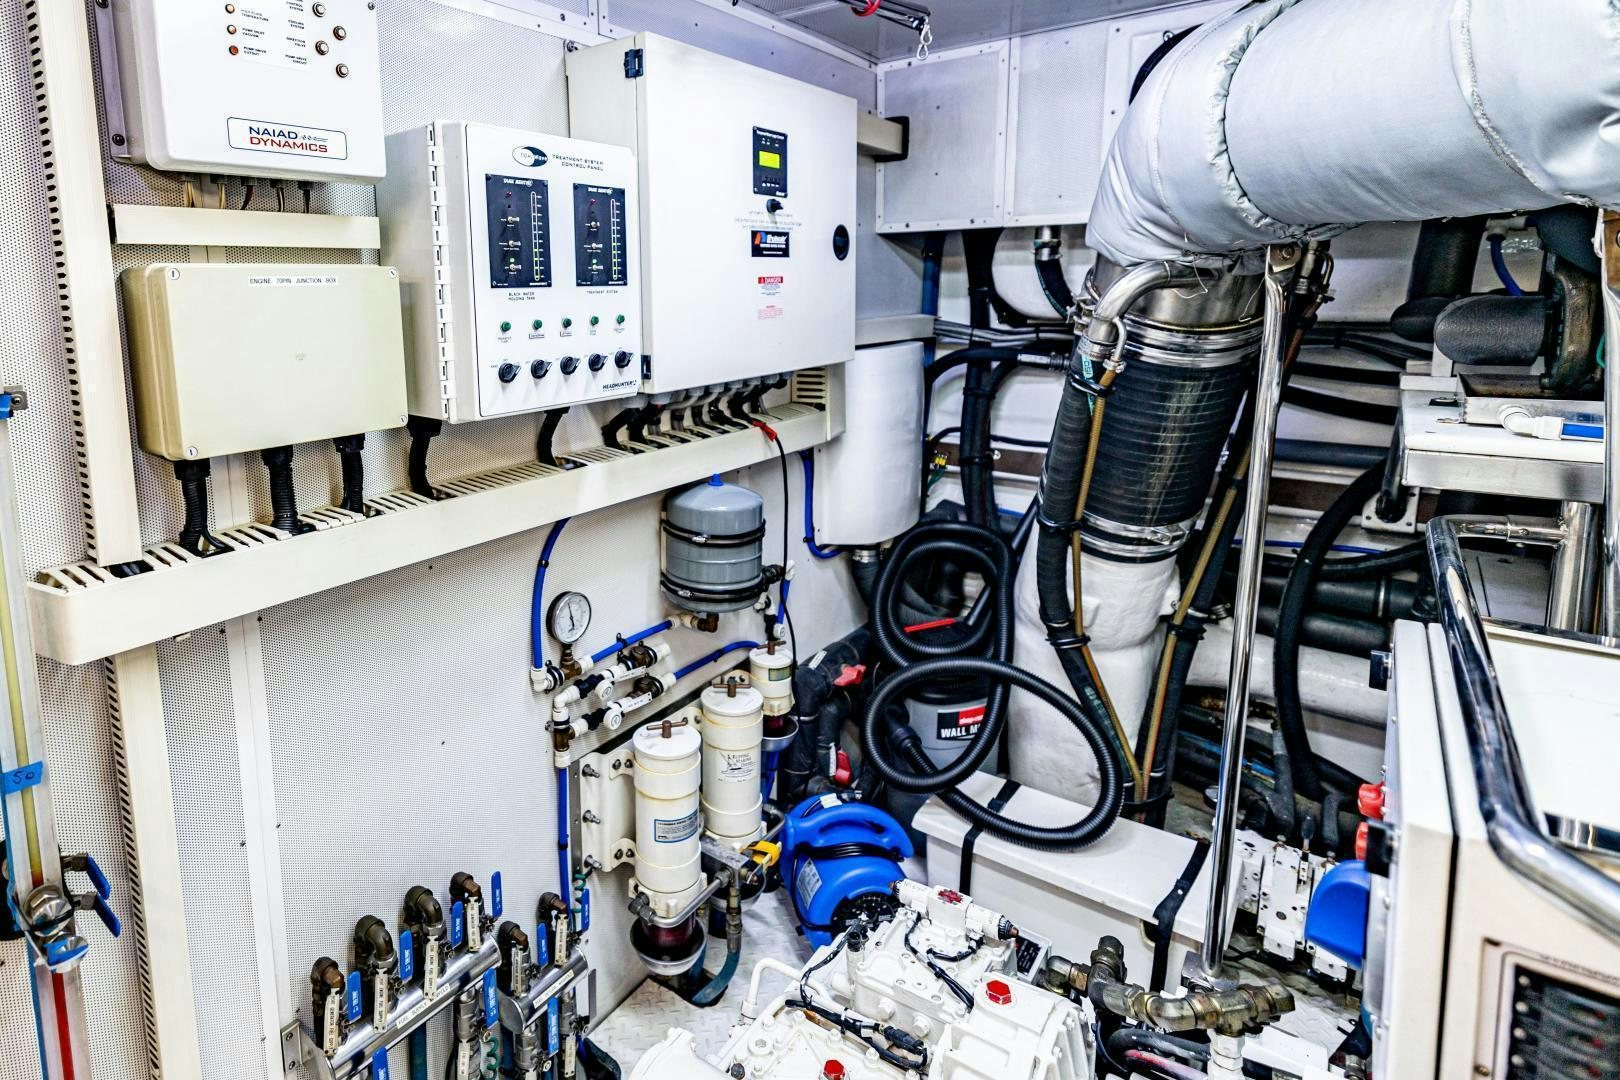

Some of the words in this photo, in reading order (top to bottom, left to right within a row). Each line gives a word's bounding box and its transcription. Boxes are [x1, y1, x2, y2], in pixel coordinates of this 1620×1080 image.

[249, 126, 298, 140] NAIAD
[250, 136, 328, 153] DYNAMICS
[552, 153, 583, 163] TREATMENT
[561, 161, 585, 169] CONTROL
[602, 380, 633, 390] HEADHUNTER
[940, 726, 967, 738] WALL
[12, 770, 35, 785] 50
